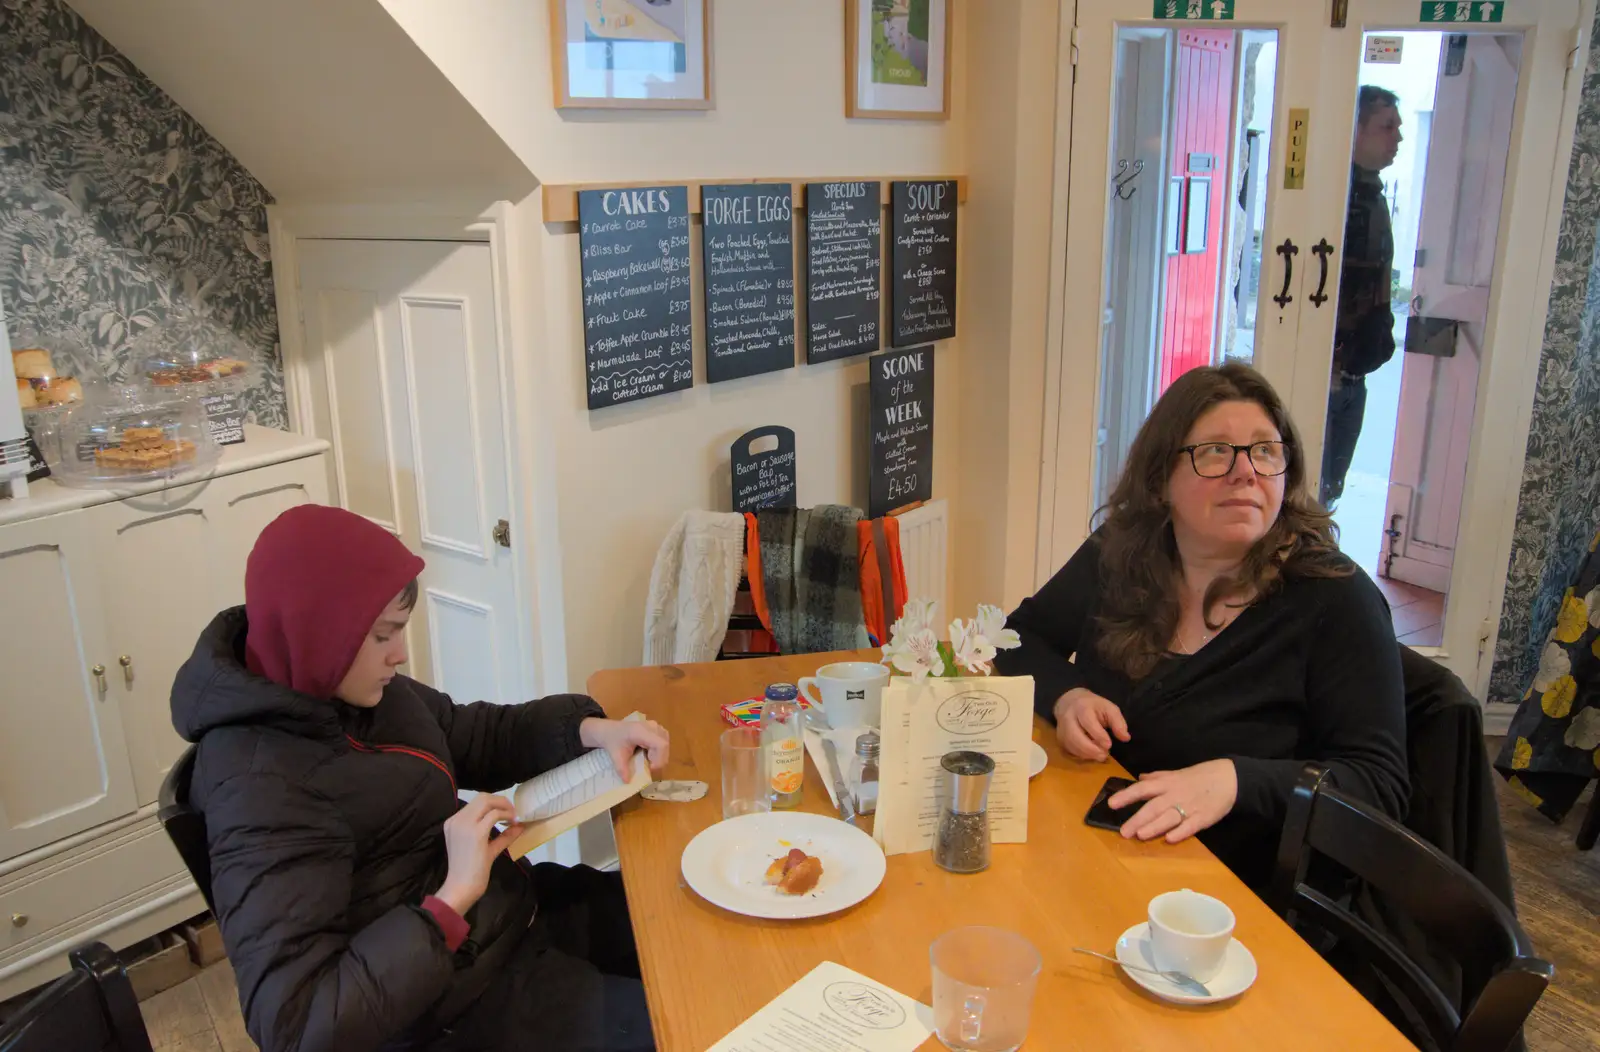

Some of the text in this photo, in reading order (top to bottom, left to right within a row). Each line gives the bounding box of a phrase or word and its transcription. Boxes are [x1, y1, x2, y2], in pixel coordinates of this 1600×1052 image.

[1291, 120, 1302, 177] PULL
[825, 183, 865, 198] SPECIALS
[908, 184, 945, 210] SOUP
[603, 190, 669, 215] CAKES
[705, 196, 790, 225] FORGE EGGS
[592, 222, 620, 233] Carrot
[626, 220, 647, 230] Cake
[591, 245, 612, 256] Bliss
[614, 244, 632, 254] Bar
[709, 237, 724, 248] Two
[727, 234, 751, 248] Poached
[712, 251, 733, 265] English
[758, 249, 769, 258] and
[593, 268, 628, 284] Raspberry
[630, 257, 660, 274] Bakewell
[593, 291, 612, 305] Apple
[620, 285, 652, 297] Cinnamon
[712, 283, 735, 296] Spinach
[713, 302, 733, 313] Bacon
[597, 313, 620, 326] Fruit
[623, 309, 647, 320] Cake
[713, 316, 738, 328] Smoked
[595, 338, 619, 352] Toffee
[620, 333, 640, 347] Apple
[597, 352, 641, 369] Marmalade
[645, 346, 662, 359] Loaf
[883, 353, 924, 379] SCONE
[591, 382, 608, 394] Add
[614, 379, 628, 388] Ice
[630, 374, 655, 385] Cream
[659, 370, 668, 378] or
[891, 380, 913, 403] of the
[613, 388, 639, 400] Clotted
[885, 400, 922, 425] WEEK
[891, 429, 899, 438] and
[737, 452, 794, 475] Bacon or Sausage
[759, 468, 773, 479] Bap
[740, 485, 752, 496] with
[779, 473, 788, 481] Tea
[726, 711, 738, 726] UNO
